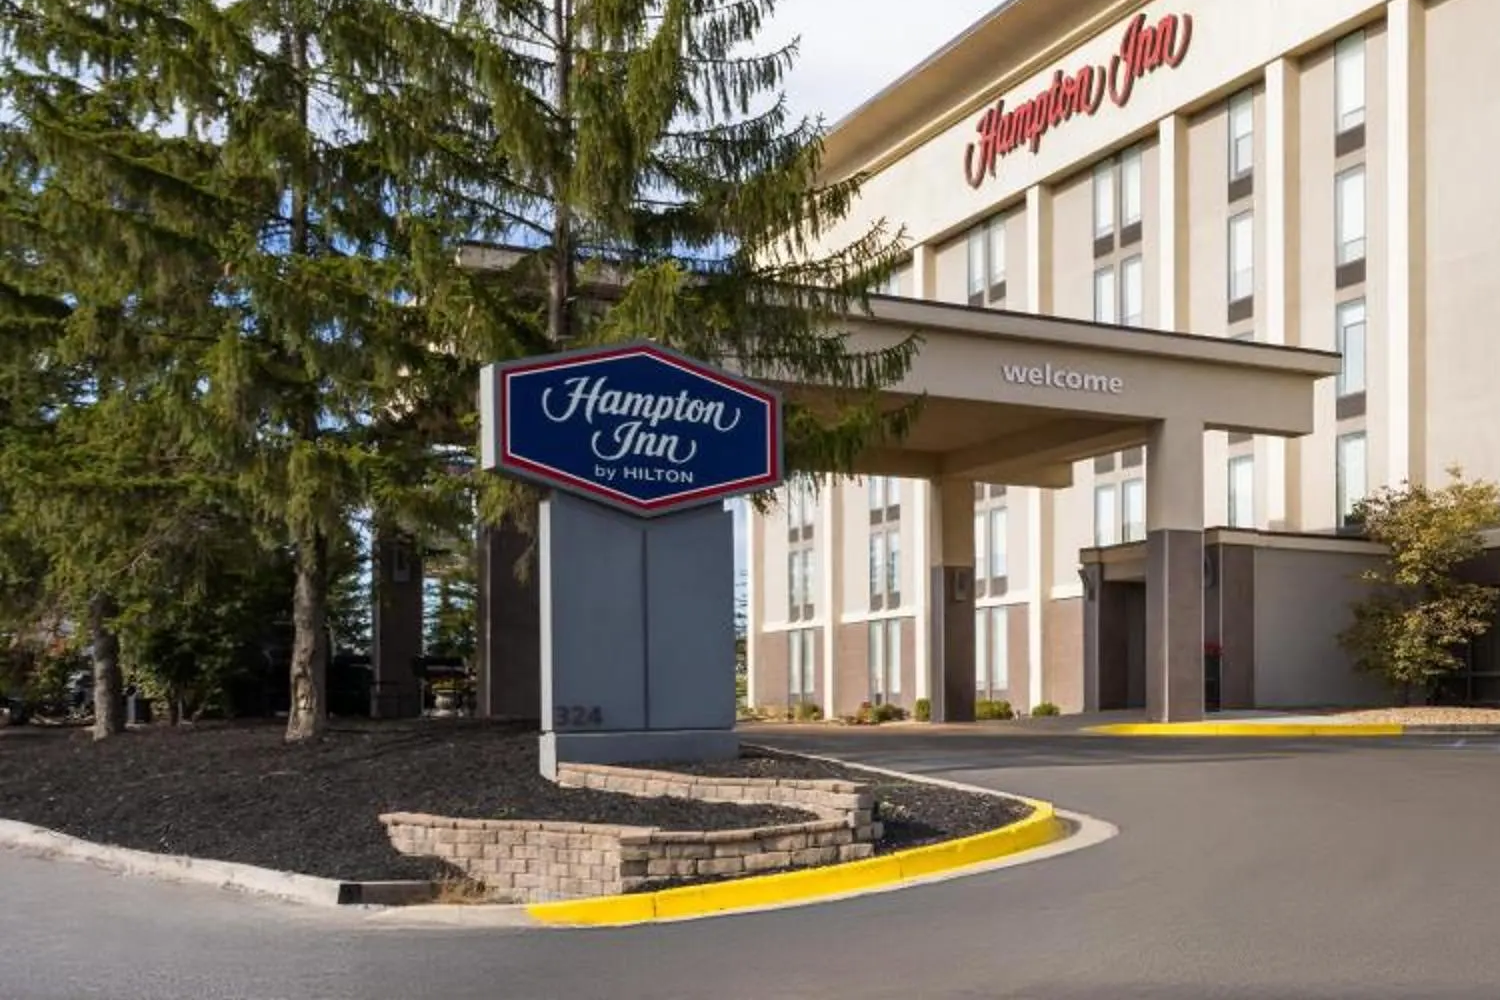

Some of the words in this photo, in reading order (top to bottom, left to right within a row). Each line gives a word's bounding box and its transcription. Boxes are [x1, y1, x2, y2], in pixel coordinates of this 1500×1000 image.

[964, 64, 1106, 189] Hampton
[1108, 13, 1192, 108] Inn
[1002, 363, 1124, 394] welcome
[541, 375, 741, 432] Hampton
[591, 420, 696, 464] Inn
[594, 464, 616, 481] by
[623, 466, 694, 484] HILTON
[554, 705, 604, 727] 324
